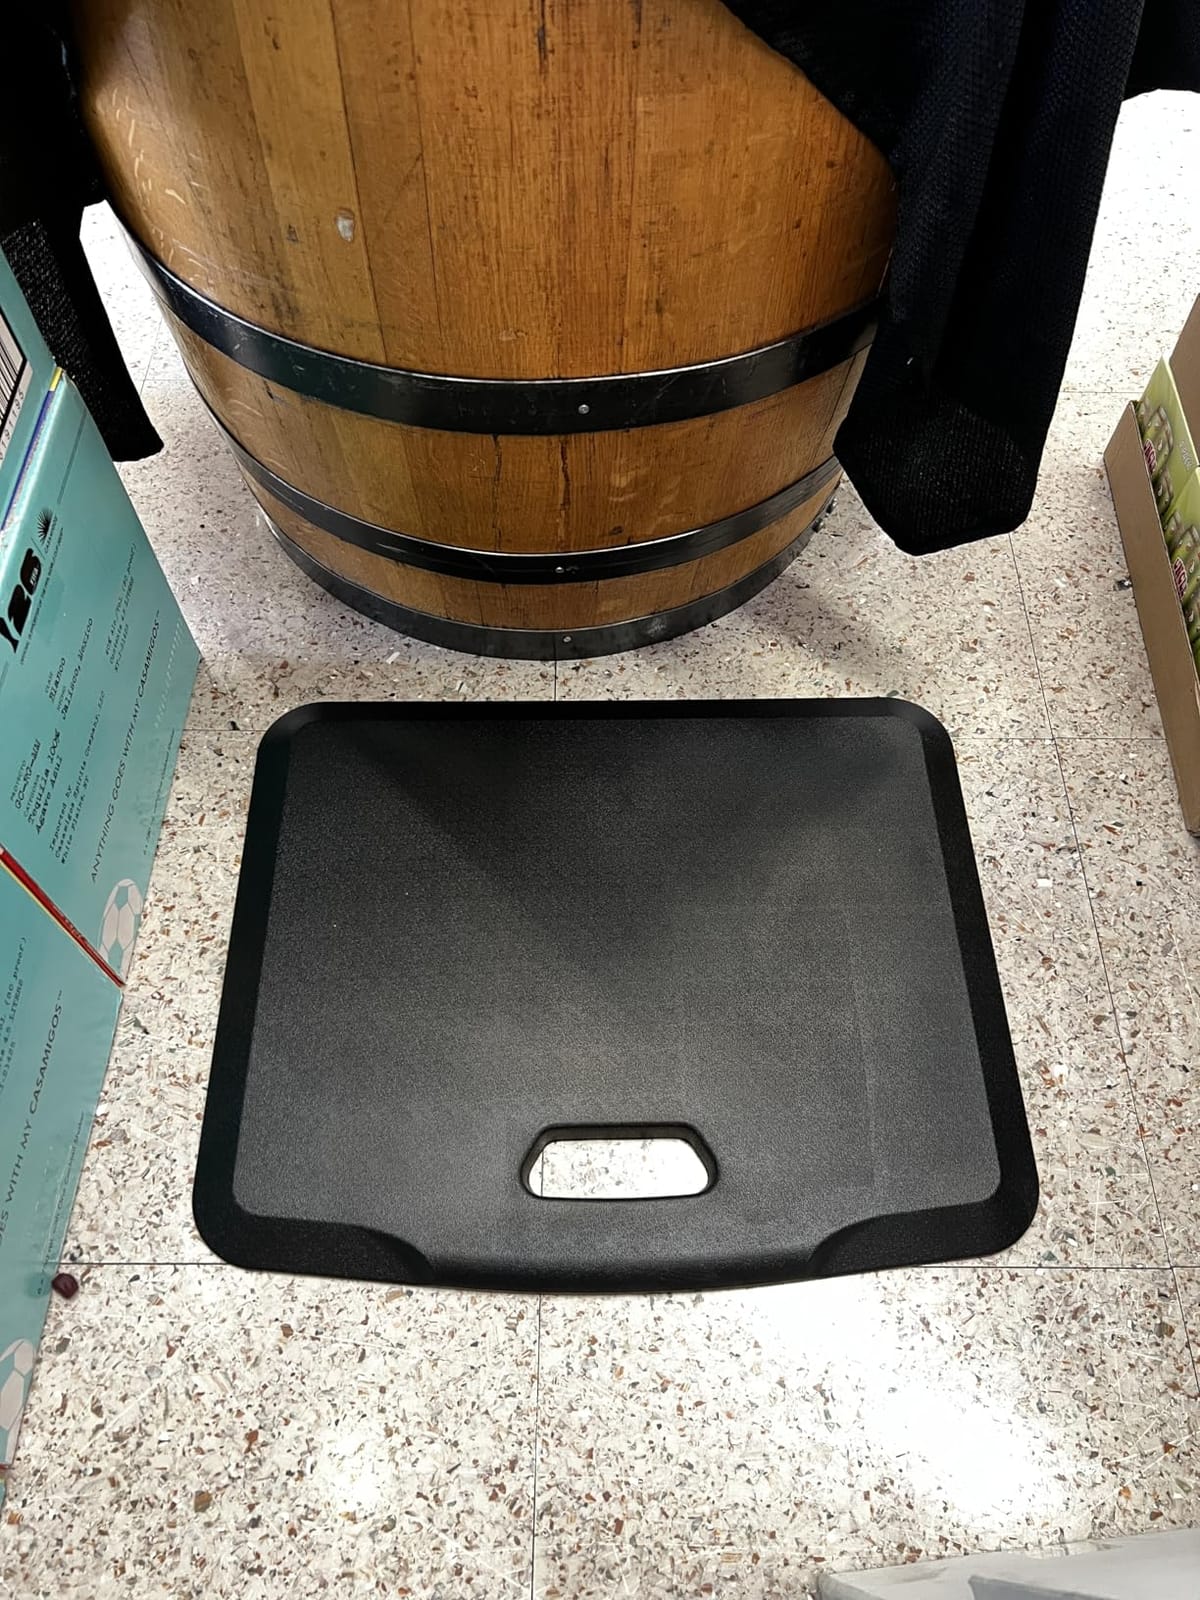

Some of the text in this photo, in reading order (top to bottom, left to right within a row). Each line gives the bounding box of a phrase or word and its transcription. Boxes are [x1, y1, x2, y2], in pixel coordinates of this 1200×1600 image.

[49, 657, 66, 704] Blanco
[61, 664, 81, 720] Jalisco,
[28, 727, 61, 825] Tequila 100%
[36, 754, 63, 835] Agave Azul
[91, 803, 115, 883] ANYTHING
[113, 760, 127, 801] GOES
[122, 719, 136, 757] WITH
[132, 697, 141, 719] MY
[50, 802, 67, 852] Imported
[55, 802, 75, 858] Casamigos
[6, 1154, 23, 1203] WITH
[21, 1120, 33, 1150] MY
